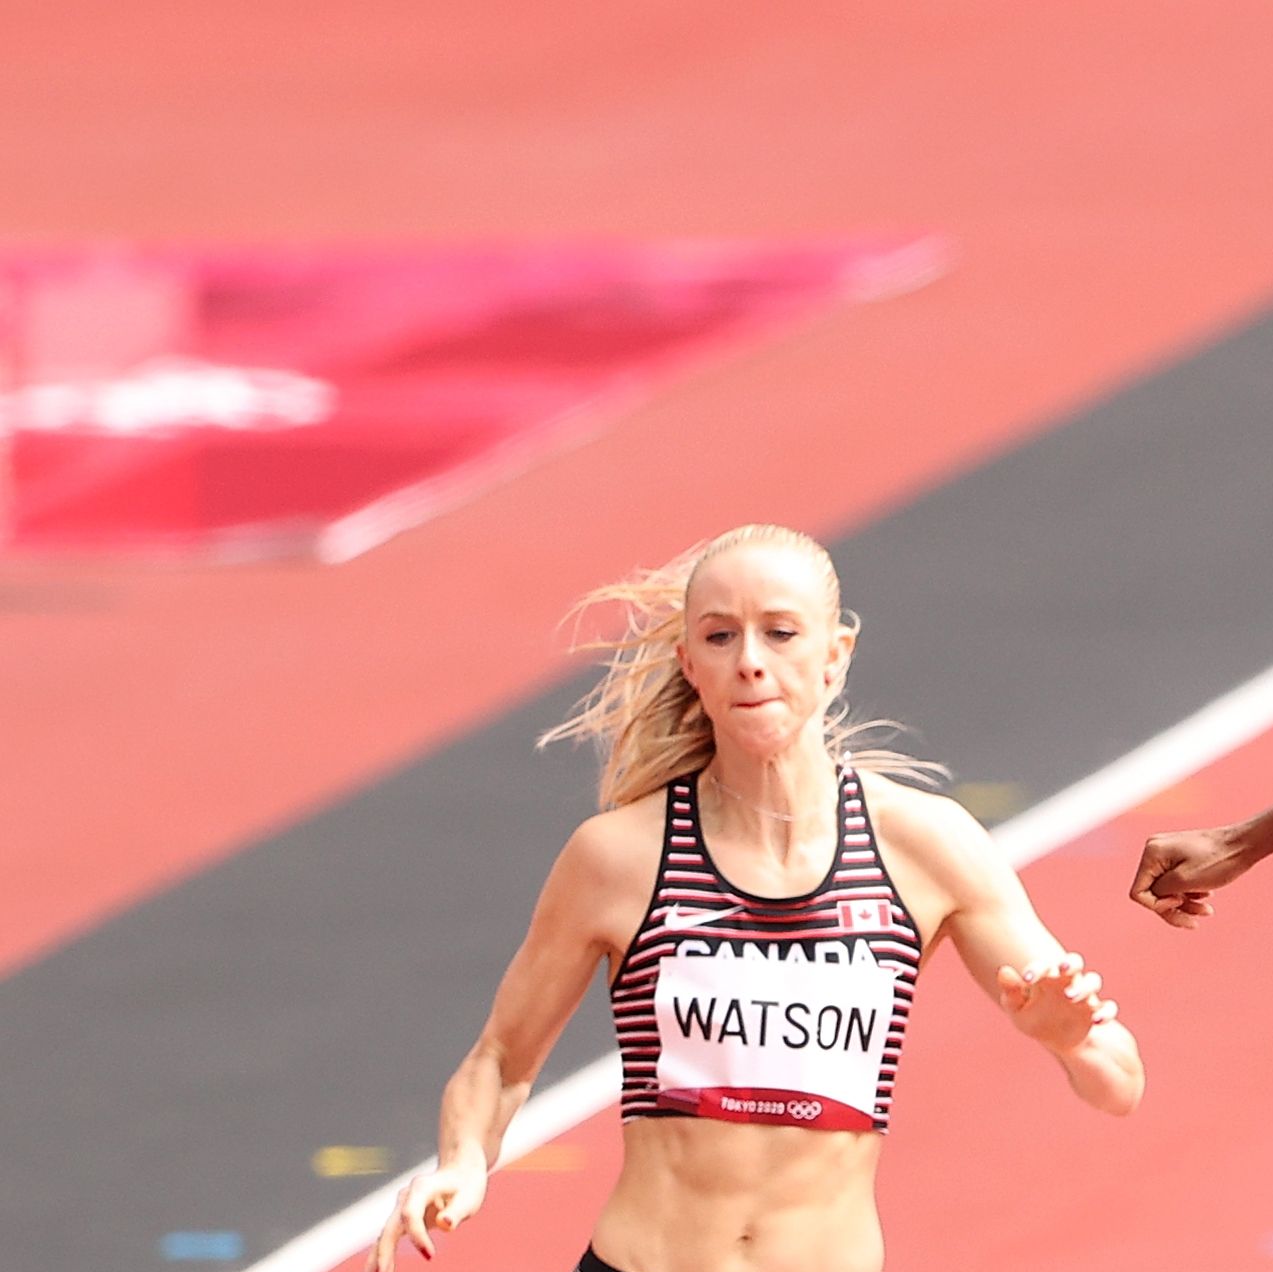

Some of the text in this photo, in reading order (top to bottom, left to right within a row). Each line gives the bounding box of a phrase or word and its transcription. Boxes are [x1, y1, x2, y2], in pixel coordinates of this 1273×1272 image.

[672, 996, 877, 1053] WATSON
[720, 1096, 785, 1115] TOKYO 2020
